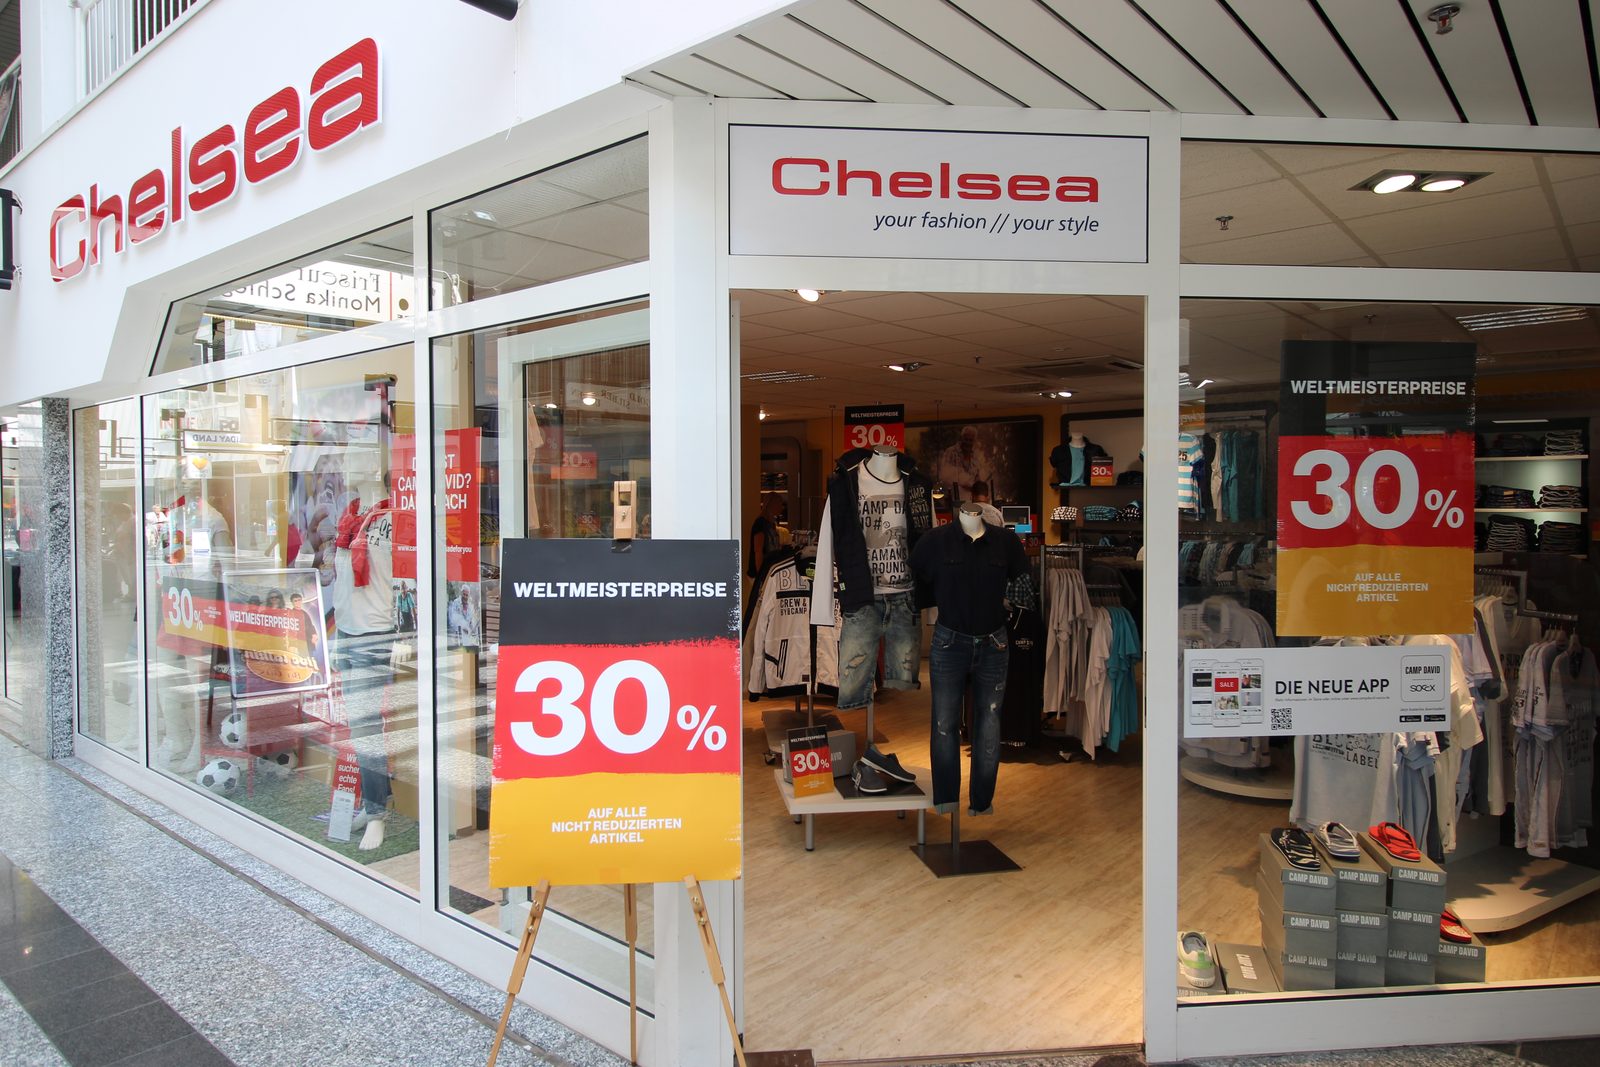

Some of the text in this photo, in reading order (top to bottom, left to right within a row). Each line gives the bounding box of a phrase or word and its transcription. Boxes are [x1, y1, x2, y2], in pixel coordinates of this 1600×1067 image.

[50, 37, 382, 283] Chelsea
[772, 156, 1099, 203] Chelsea
[873, 213, 916, 231] your
[921, 211, 987, 229] fashion
[1011, 215, 1055, 233] your
[1058, 214, 1099, 233] style
[1291, 379, 1466, 396] WELTMEISTERPREISE
[851, 424, 898, 448] 30%
[1290, 449, 1465, 530] 30%
[1354, 573, 1401, 582] AUF ALLE
[513, 582, 727, 598] WELTMEISTERPREISE
[1326, 583, 1429, 592] NICHT REDUZIERTEN
[1356, 593, 1399, 602] ARTIKEL
[168, 586, 204, 632] 30%
[229, 608, 300, 632] WELTMEISTERPREISE
[1405, 665, 1441, 675] CAMP DAVID
[1275, 678, 1390, 695] DIE NEUE APP
[510, 659, 727, 756] 30%
[793, 751, 830, 773] 30%
[588, 806, 647, 818] AUF ALLE
[551, 818, 682, 833] NICHT REDUZIERTEN
[589, 831, 644, 844] ARTIKEL
[1288, 871, 1328, 886] CAMP DAVID
[1338, 870, 1379, 884] CAMP DAVID
[1398, 869, 1439, 883] CAMP DAVID
[1290, 916, 1330, 930] CAMP DAVID
[1340, 913, 1380, 926] CAMP DAVID
[1392, 910, 1433, 924] CAMP DAVID
[1337, 951, 1377, 964] CAMP DAVID
[1388, 949, 1428, 963] CAMP DAVID
[1438, 943, 1479, 958] CAMP DAVID
[1288, 954, 1328, 968] CAMP DAVID
